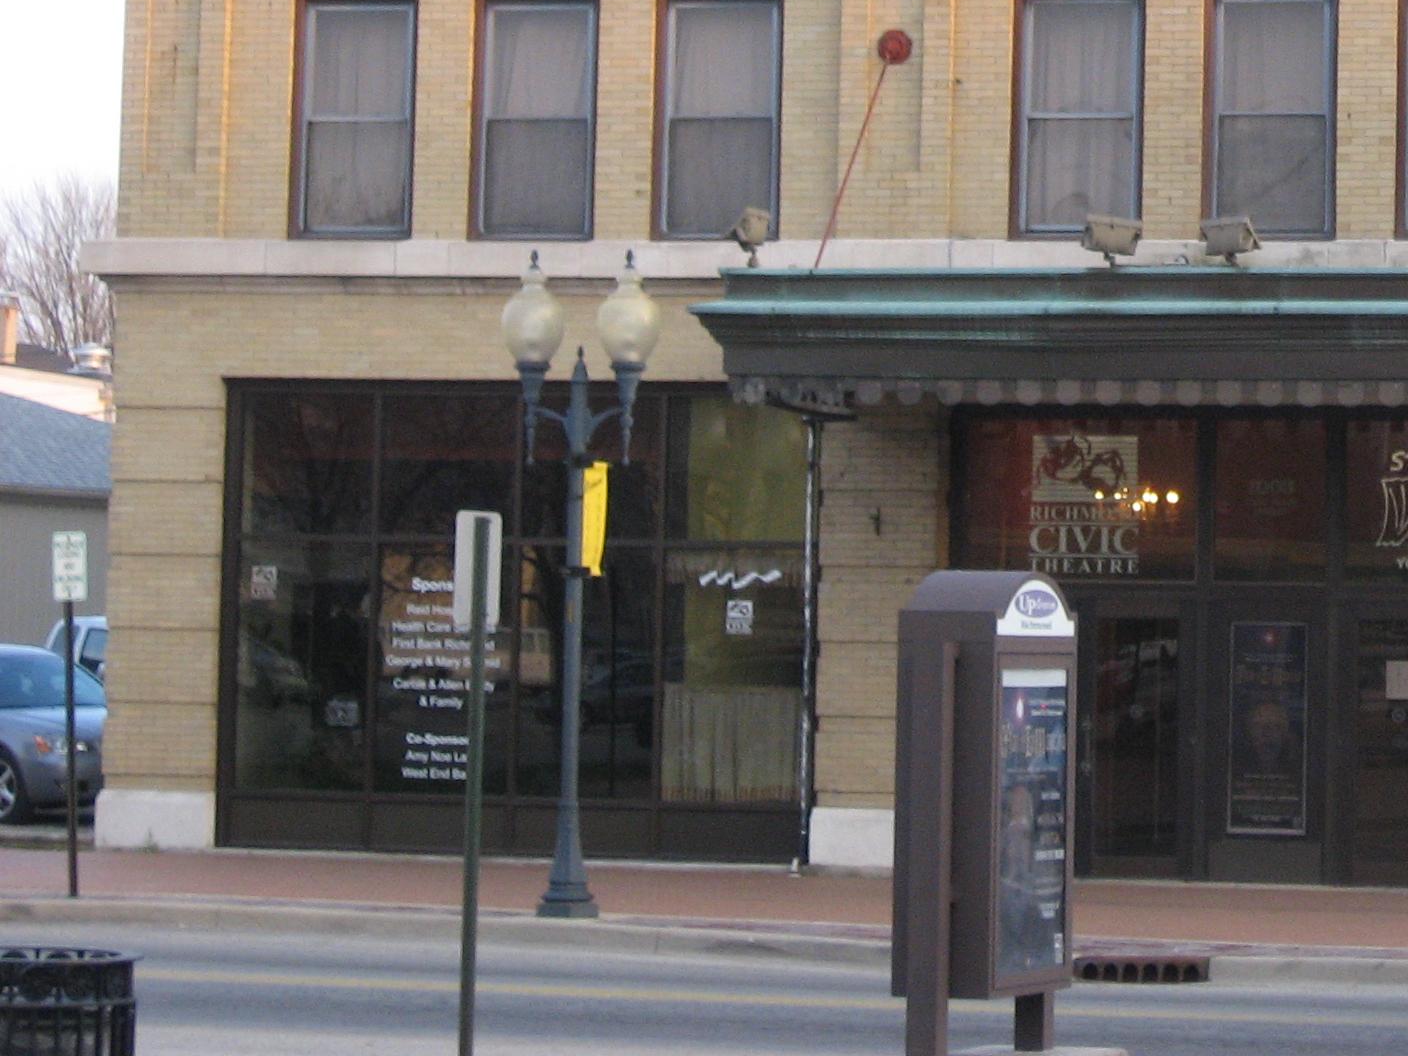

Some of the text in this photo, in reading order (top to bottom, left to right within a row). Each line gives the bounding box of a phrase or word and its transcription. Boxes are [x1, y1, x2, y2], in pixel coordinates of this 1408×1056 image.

[1029, 525, 1139, 555] CIVIC
[1030, 557, 1139, 574] THEATRE
[391, 621, 425, 633] Health
[426, 621, 451, 633] Care
[385, 655, 423, 668] George
[435, 655, 460, 668] Mary
[419, 696, 428, 709] &
